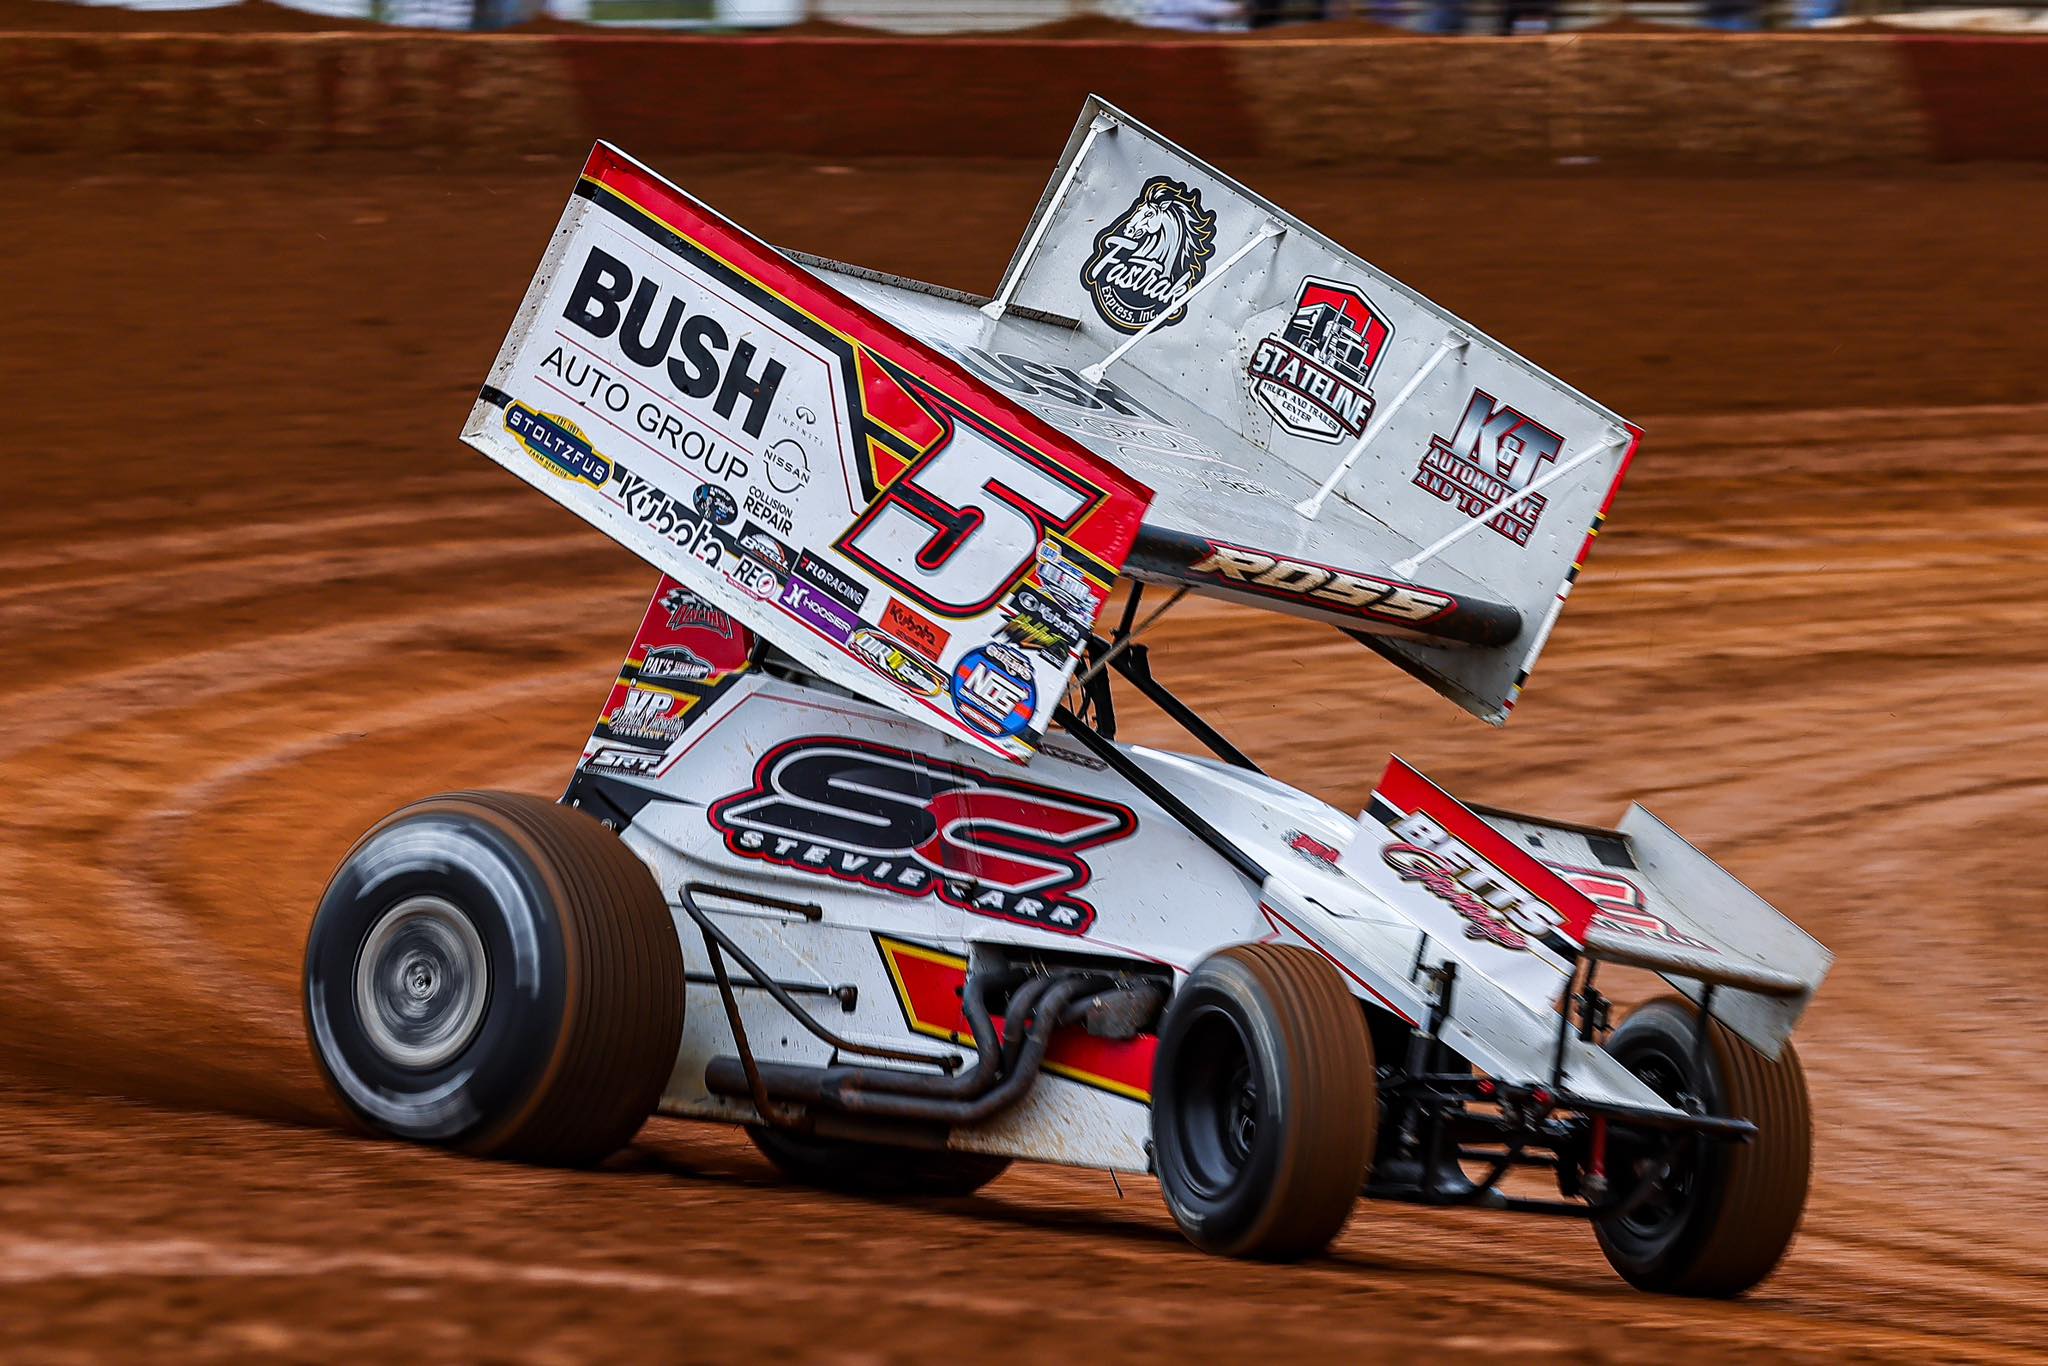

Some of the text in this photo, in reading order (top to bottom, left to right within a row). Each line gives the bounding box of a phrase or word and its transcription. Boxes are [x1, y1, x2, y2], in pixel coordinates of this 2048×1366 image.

[1091, 235, 1192, 304] Fastrak
[1101, 285, 1159, 323] Express, Inc.
[561, 245, 788, 441] BUSH
[1252, 341, 1372, 433] STATELINE
[1262, 381, 1339, 432] TRUCK AND TRAILER
[1281, 400, 1312, 423] CENTER
[540, 347, 749, 482] AUTO GROUP
[776, 413, 825, 447] INFINITI
[1288, 414, 1300, 424] LLC
[510, 411, 606, 481] STOLTZFUS
[528, 449, 568, 480] FARM SERVICE
[763, 448, 811, 485] NISSAN
[748, 485, 794, 519] COLLISION
[1416, 469, 1530, 542] AND TOING
[1426, 447, 1541, 521] AUTOMOTVE
[743, 495, 794, 537] REPAIR
[846, 413, 1094, 607] 5
[1189, 544, 1453, 622] ROSS
[889, 603, 937, 646] Kubota
[1038, 604, 1080, 641] Kubota
[642, 656, 674, 676] PAT'S
[964, 661, 1030, 714] NOS
[624, 687, 674, 720] VP
[593, 749, 661, 769] SRT
[720, 745, 1122, 894] SC
[739, 830, 1080, 926] STEVIE CARR
[1390, 809, 1570, 938] BETTS
